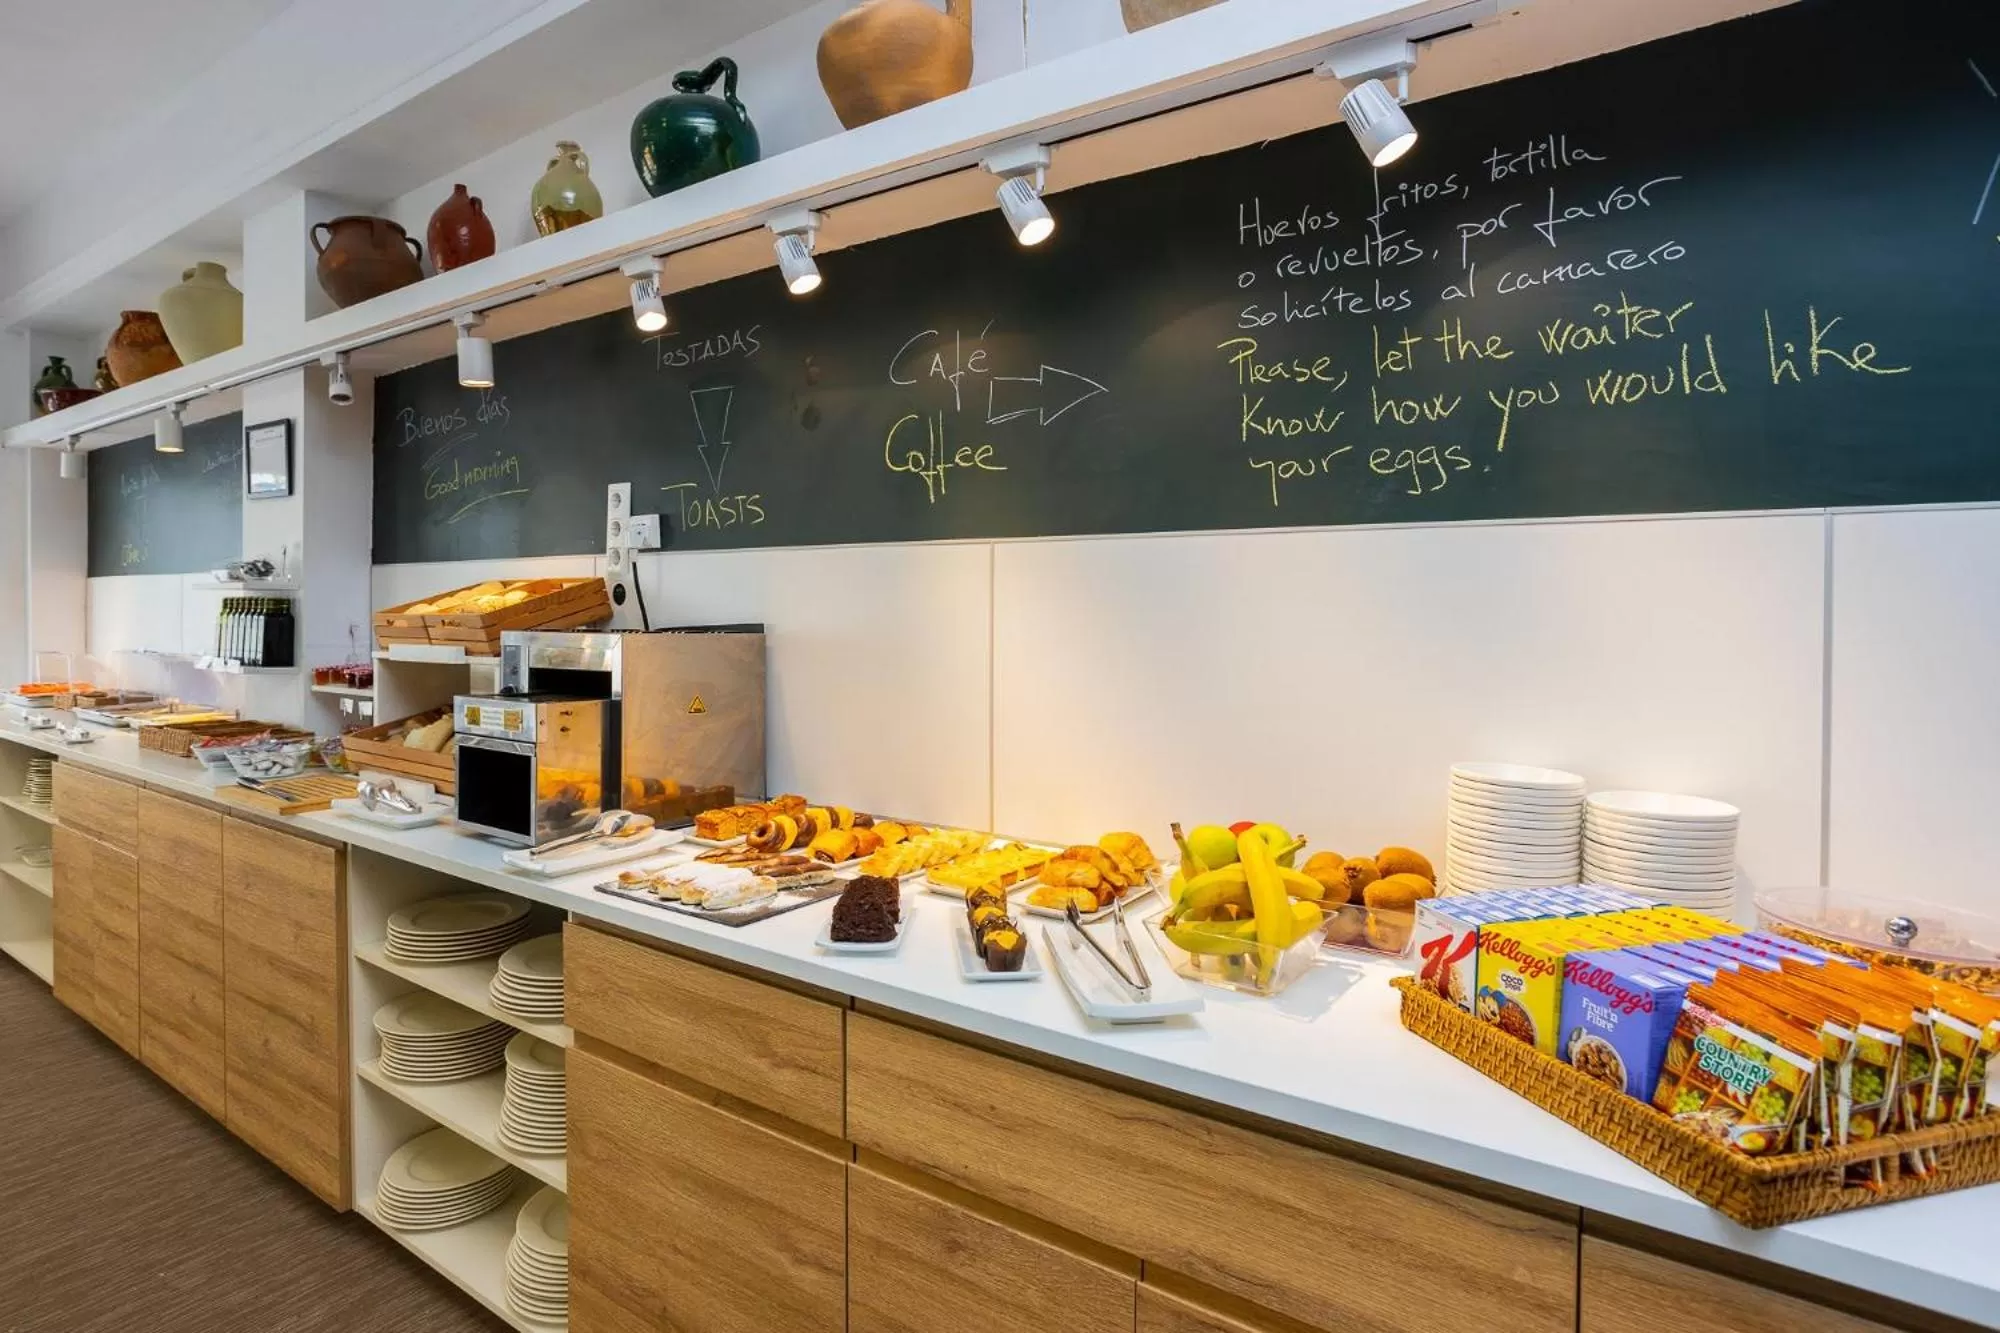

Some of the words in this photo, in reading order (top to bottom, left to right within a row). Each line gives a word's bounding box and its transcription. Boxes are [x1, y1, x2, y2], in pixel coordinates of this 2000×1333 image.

[1238, 198, 1339, 249] Huevos
[1484, 133, 1606, 181] tortilla
[1238, 271, 1255, 288] o
[1277, 230, 1439, 279] revueltos,
[1458, 204, 1523, 266] por
[1533, 176, 1682, 246] favor
[1238, 283, 1411, 329] solicítelos
[1441, 264, 1474, 300] al
[1497, 241, 1686, 295] camarero
[1218, 337, 1349, 391] Please,
[1374, 326, 1417, 379] let
[1436, 319, 1513, 361] the
[1539, 291, 1695, 354] waiter
[1373, 387, 1461, 426] how
[1491, 381, 1559, 452] you
[1587, 336, 1726, 405] would
[885, 411, 1007, 502] Coffee
[1249, 446, 1352, 505] your
[1369, 443, 1491, 495] eggs.
[661, 483, 765, 532] TOASTS
[1479, 931, 1556, 978] Kellogg's
[1564, 960, 1654, 1014] Kellogg's
[1695, 1036, 1774, 1084] COUNTRY
[1701, 1055, 1755, 1093] STORE
